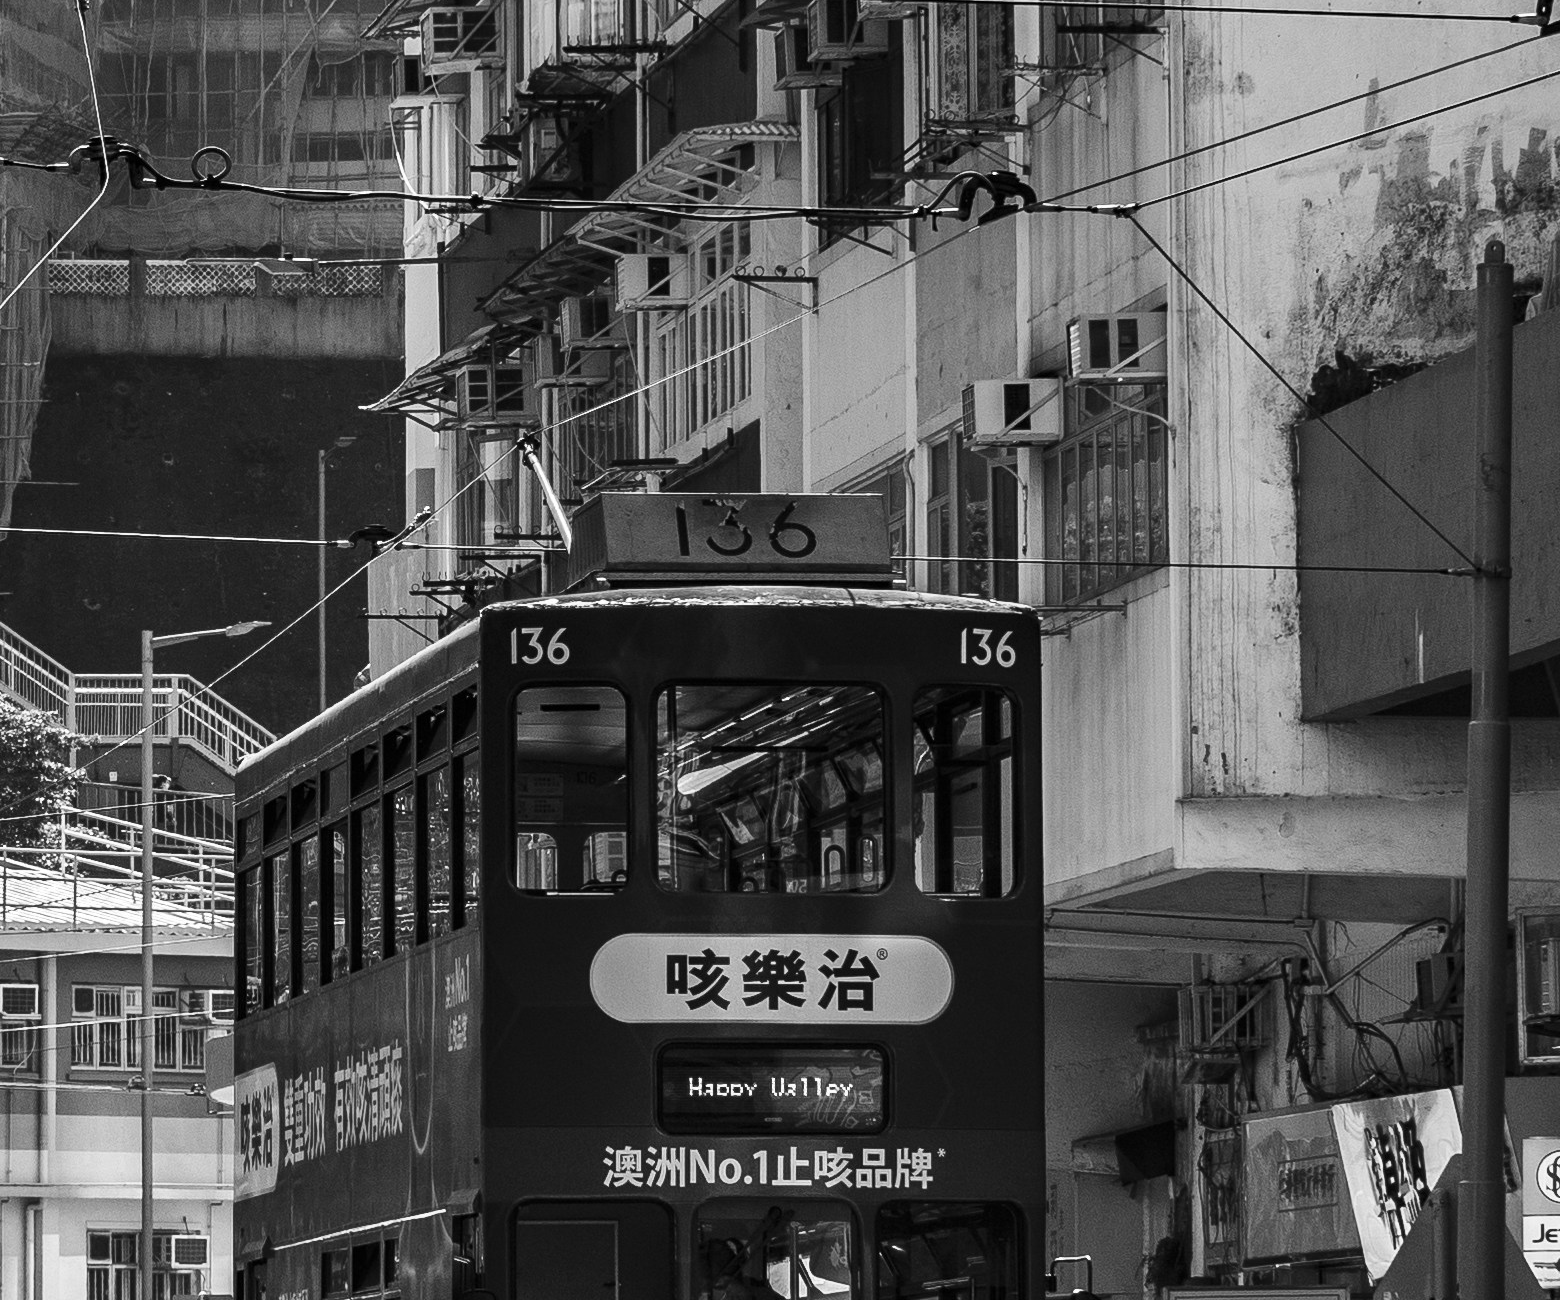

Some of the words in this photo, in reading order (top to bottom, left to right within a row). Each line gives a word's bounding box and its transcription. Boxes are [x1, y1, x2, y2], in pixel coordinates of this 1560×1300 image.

[675, 500, 817, 559] 136
[510, 626, 571, 665] 136
[960, 627, 1017, 668] 136
[666, 948, 881, 1012] 咳樂治
